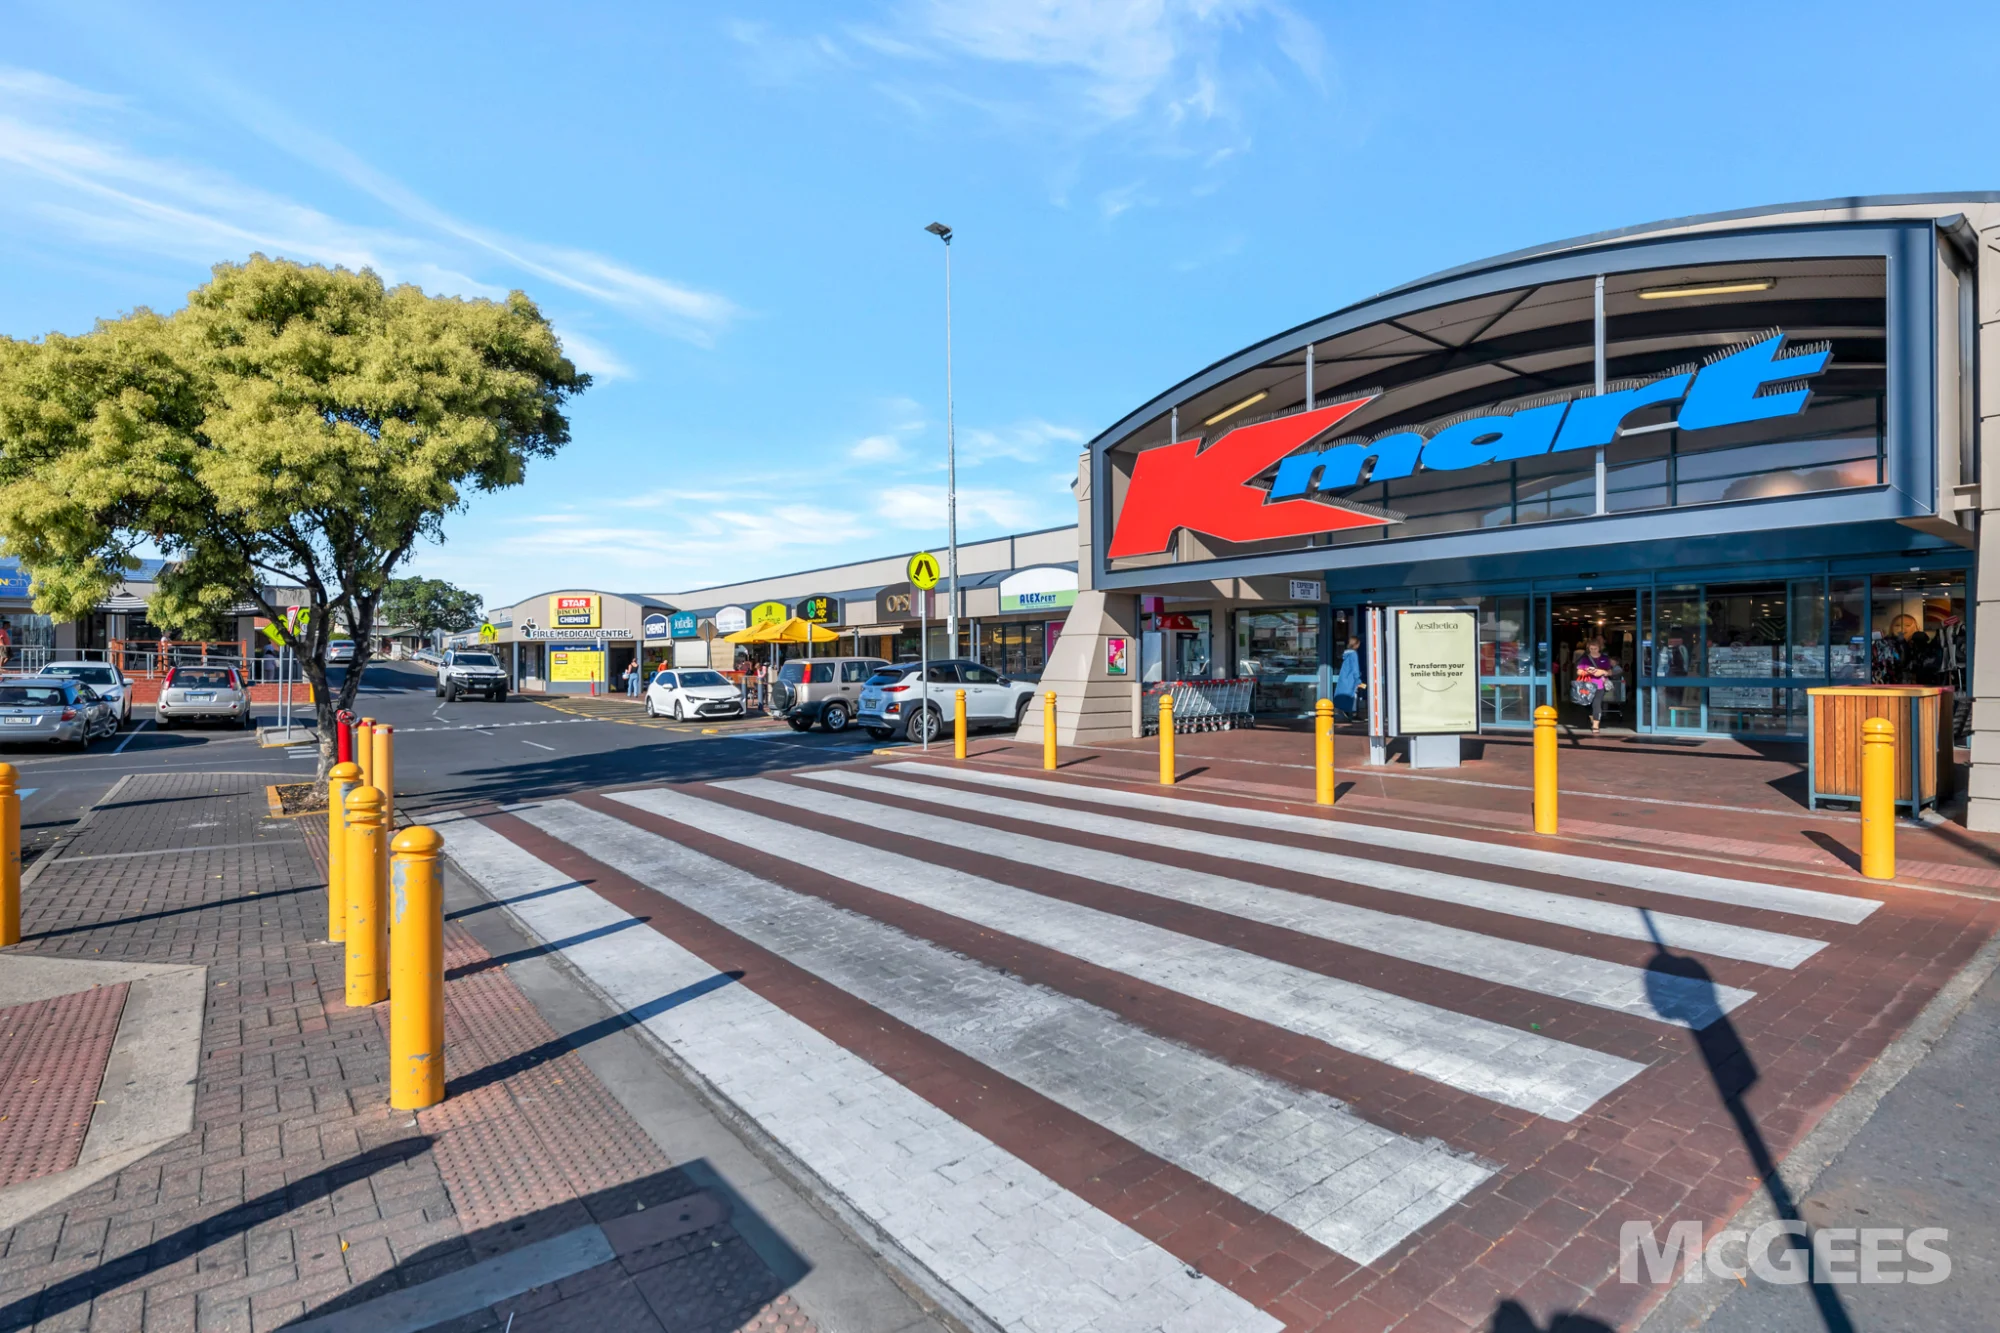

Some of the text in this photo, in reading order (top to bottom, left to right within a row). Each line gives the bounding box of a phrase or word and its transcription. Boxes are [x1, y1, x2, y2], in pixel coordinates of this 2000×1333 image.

[1108, 330, 1832, 559] Kmart
[561, 599, 587, 607] STAR
[886, 594, 911, 613] OPS
[559, 615, 590, 624] CHEMIST
[1414, 621, 1459, 630] Aesthetica
[532, 629, 629, 638] FIRLE MEDICAL CENTRE
[1432, 669, 1446, 677] this
